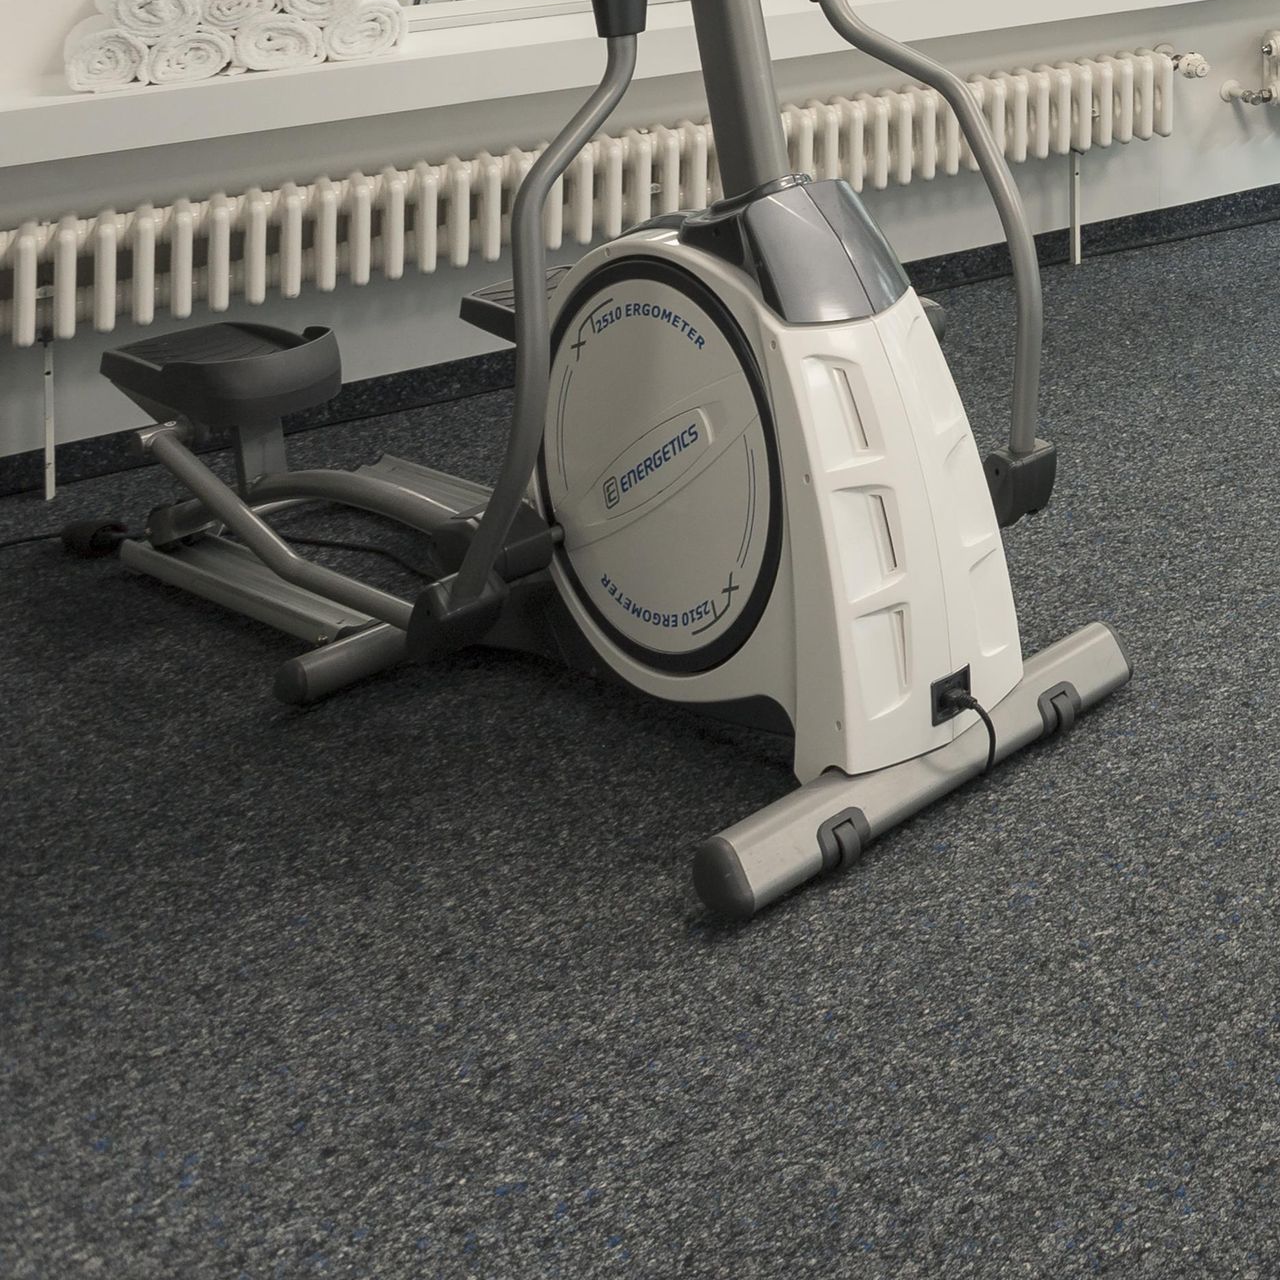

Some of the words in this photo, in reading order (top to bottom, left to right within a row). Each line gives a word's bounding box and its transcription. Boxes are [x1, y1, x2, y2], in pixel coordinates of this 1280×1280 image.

[595, 306, 622, 334] 2510
[625, 302, 706, 350] ERGOMETER
[620, 423, 699, 493] ENERGETICS
[600, 572, 678, 627] ERGOMETER
[682, 599, 712, 626] 2510
